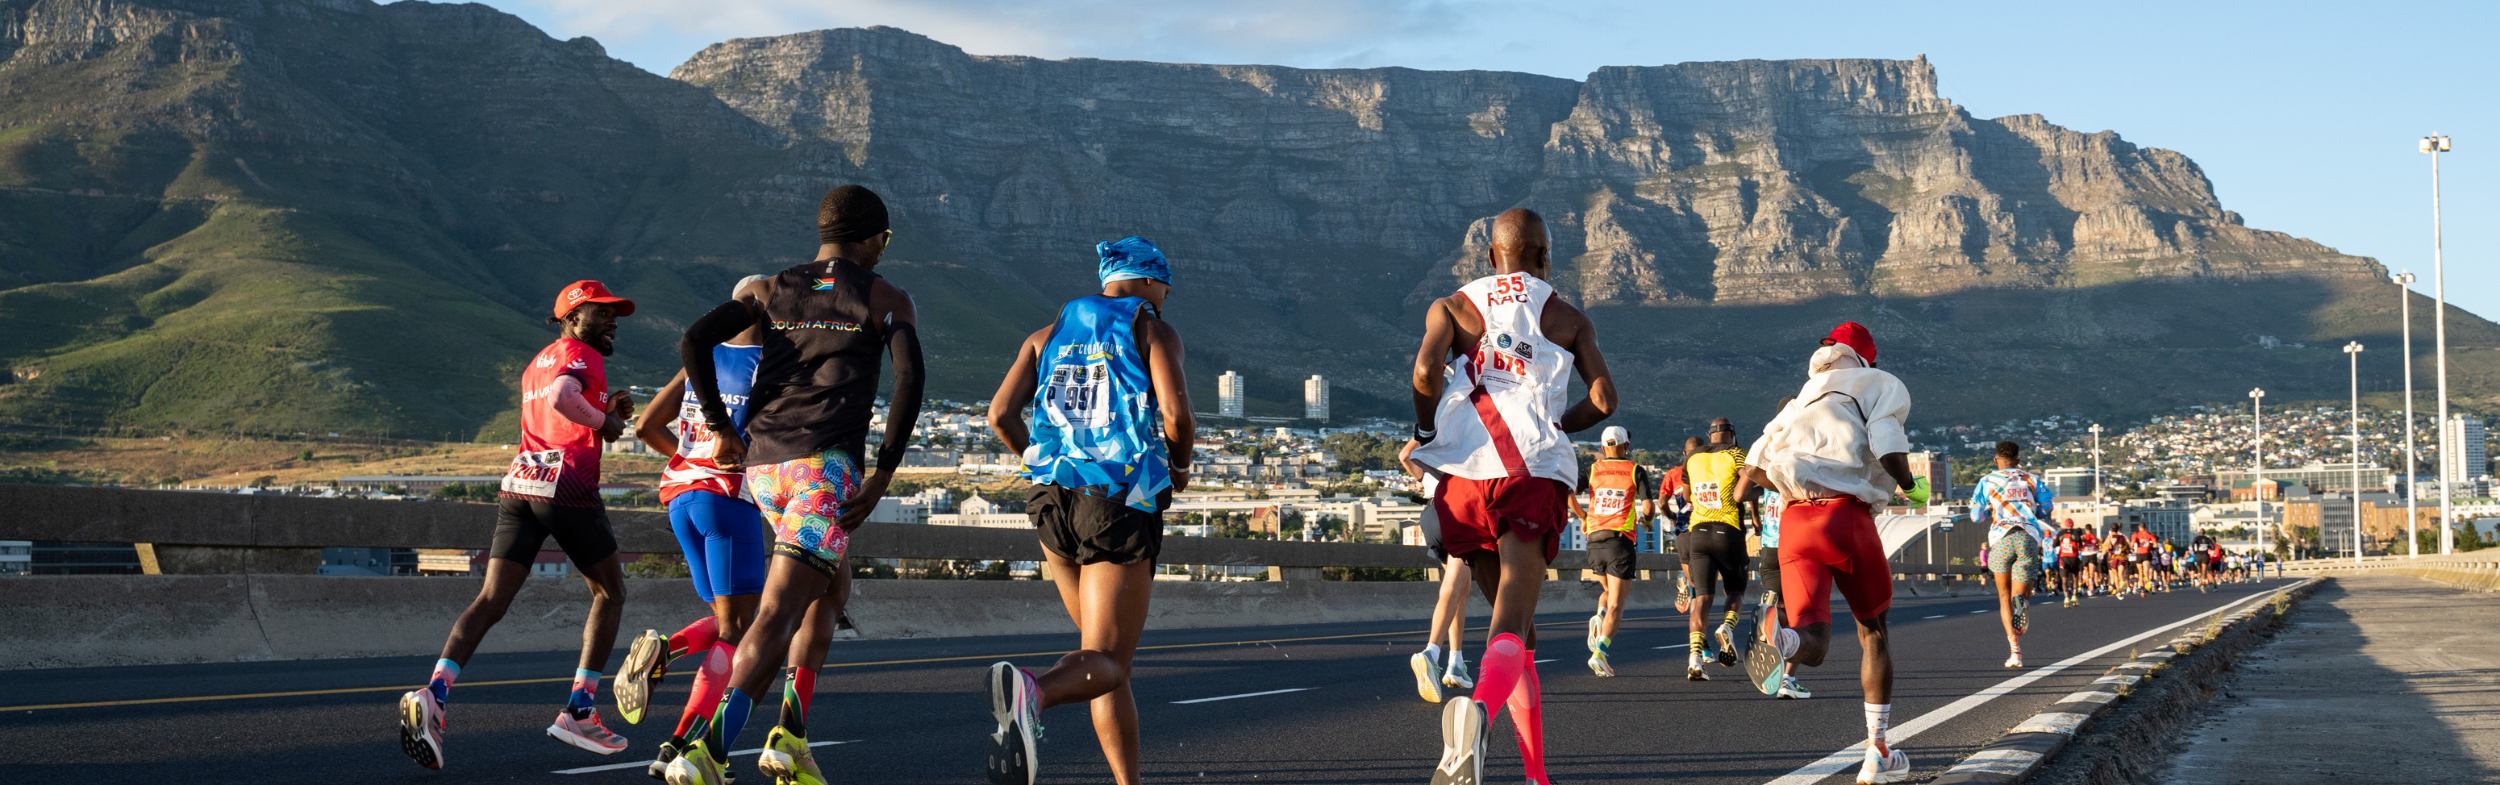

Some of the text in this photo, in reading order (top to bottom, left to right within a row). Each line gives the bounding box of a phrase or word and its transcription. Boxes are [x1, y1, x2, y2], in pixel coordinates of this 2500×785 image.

[1497, 276, 1525, 295] 55
[569, 296, 586, 305] TOYOTA
[770, 320, 862, 332] SOUTH AFRICA
[1517, 342, 1532, 353] ASA
[1475, 350, 1485, 375] P
[684, 390, 749, 406] WE OAST
[1046, 385, 1098, 411] P 991
[680, 420, 688, 436] P
[1602, 497, 1621, 509] 5281
